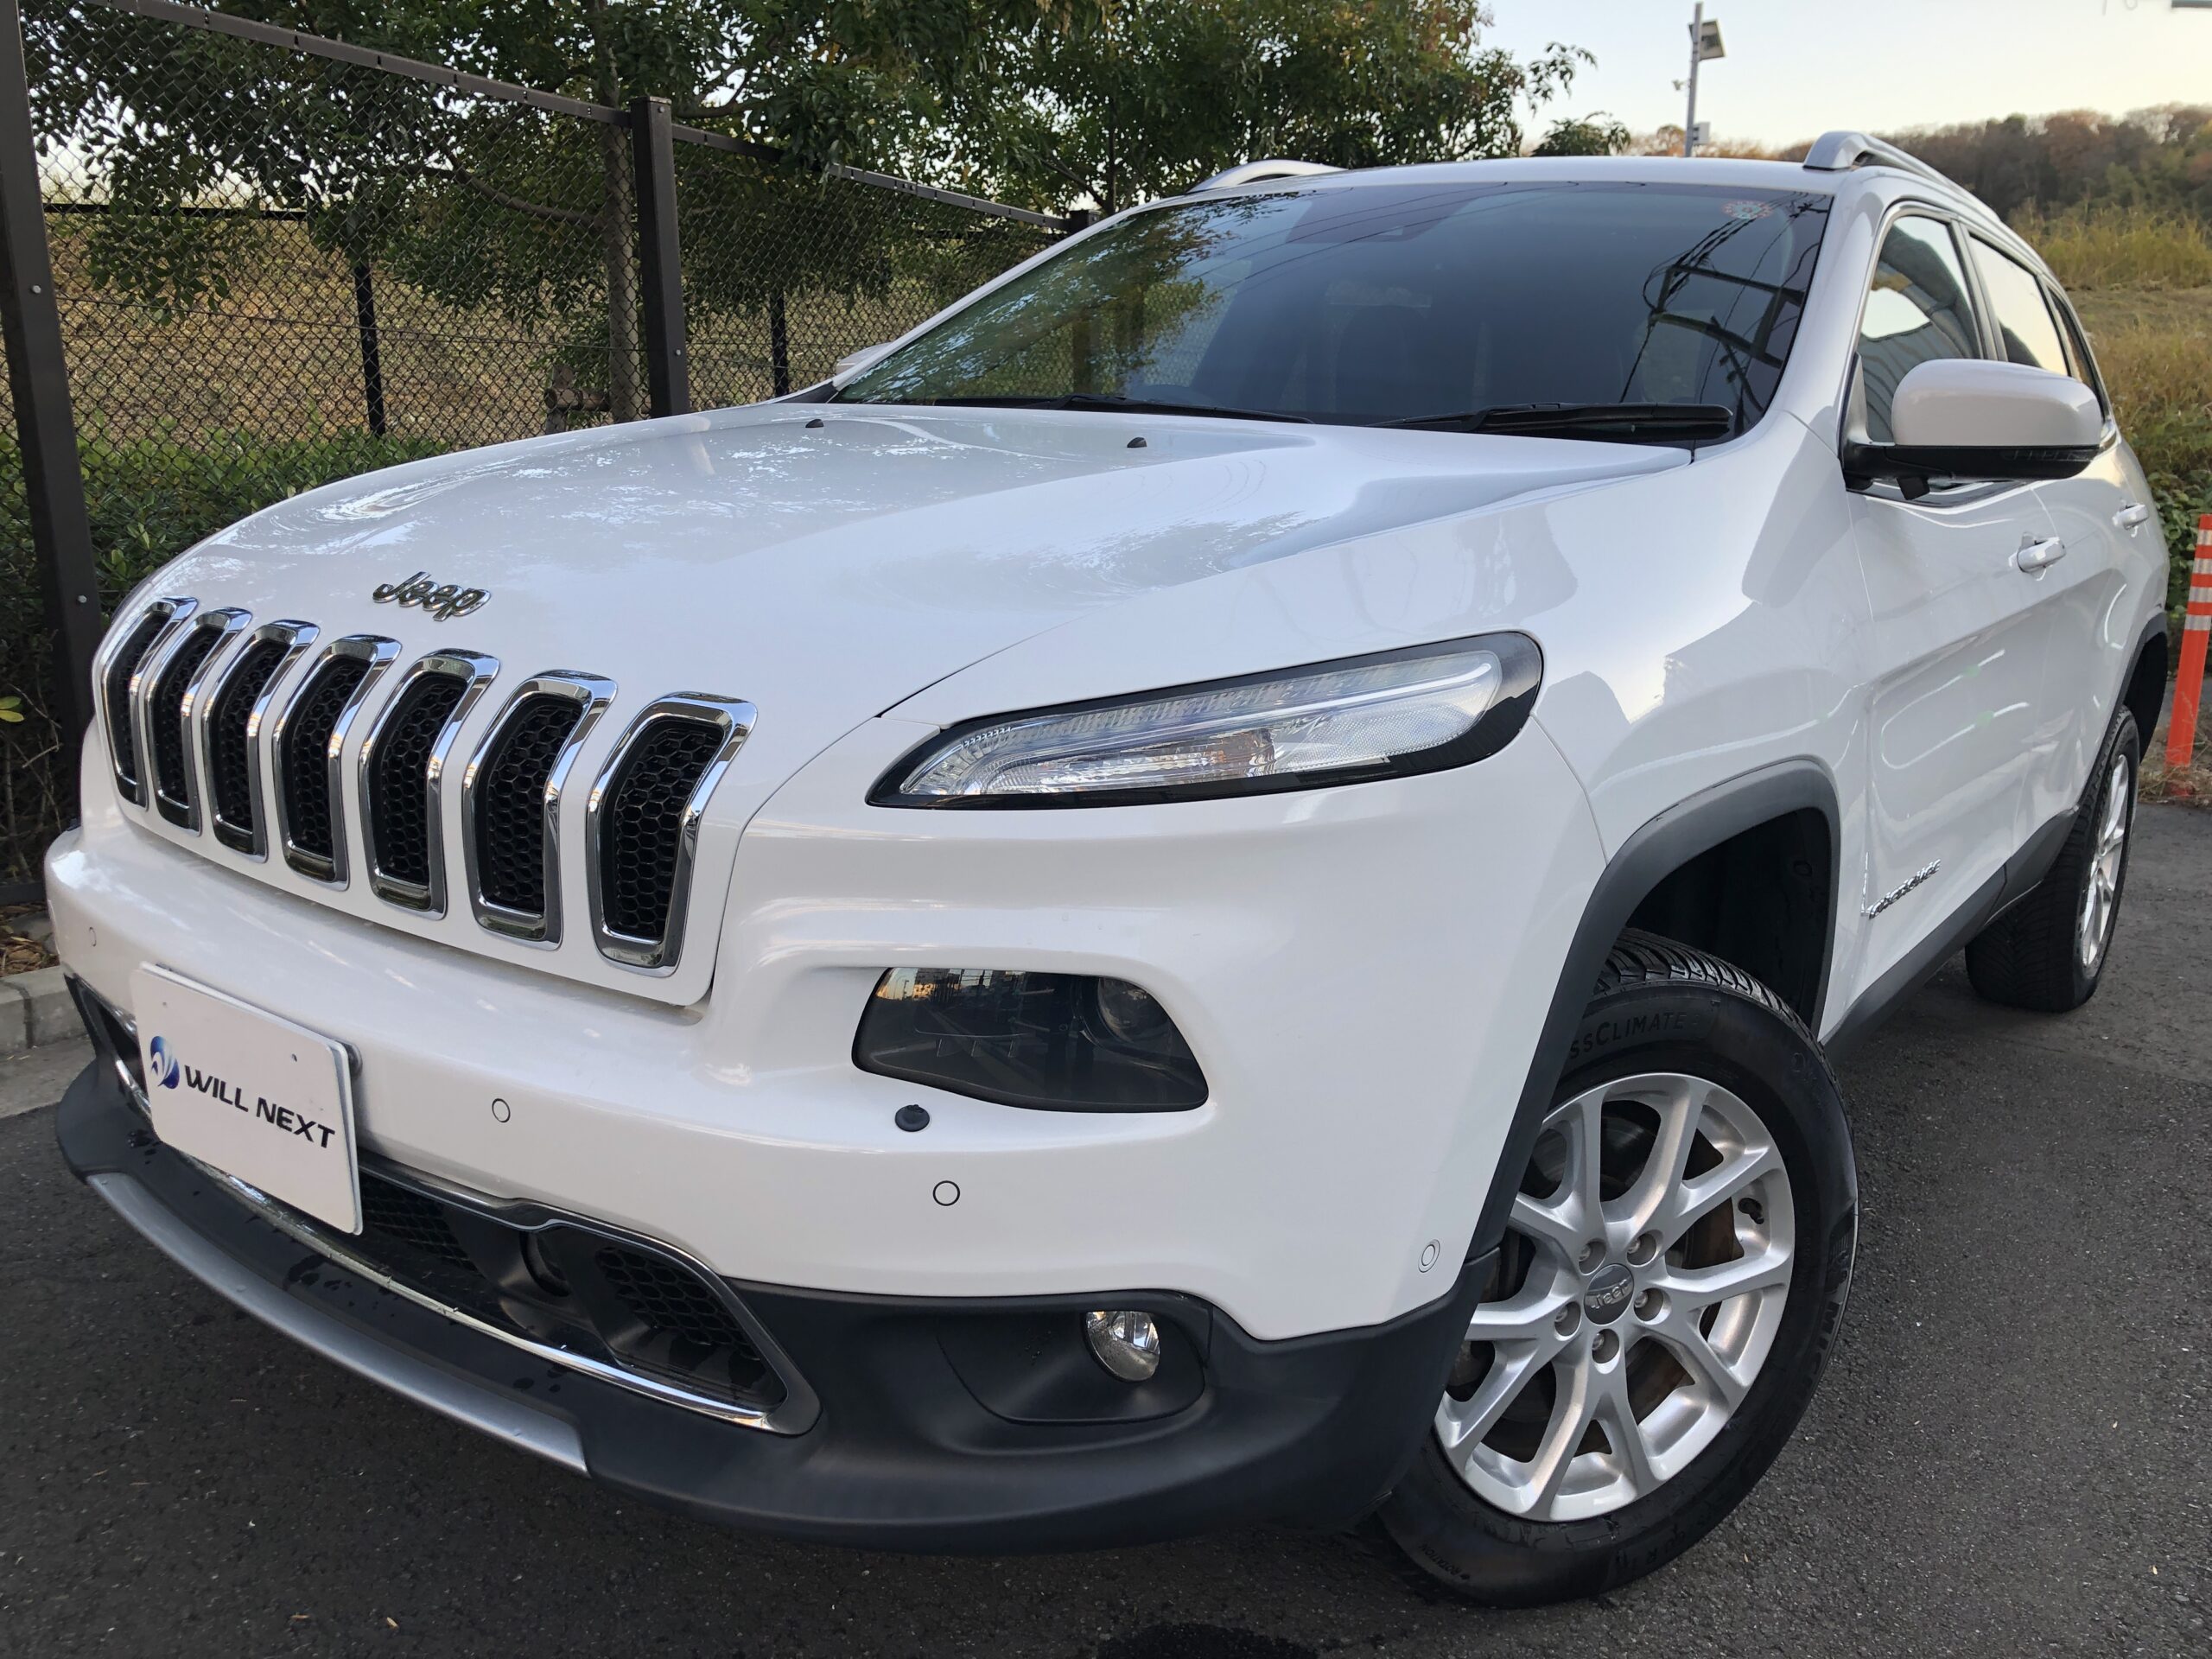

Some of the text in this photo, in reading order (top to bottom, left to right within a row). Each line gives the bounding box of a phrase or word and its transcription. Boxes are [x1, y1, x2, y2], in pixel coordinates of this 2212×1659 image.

[372, 571, 491, 621] Jeep
[184, 1065, 335, 1148] WILL NEXT
